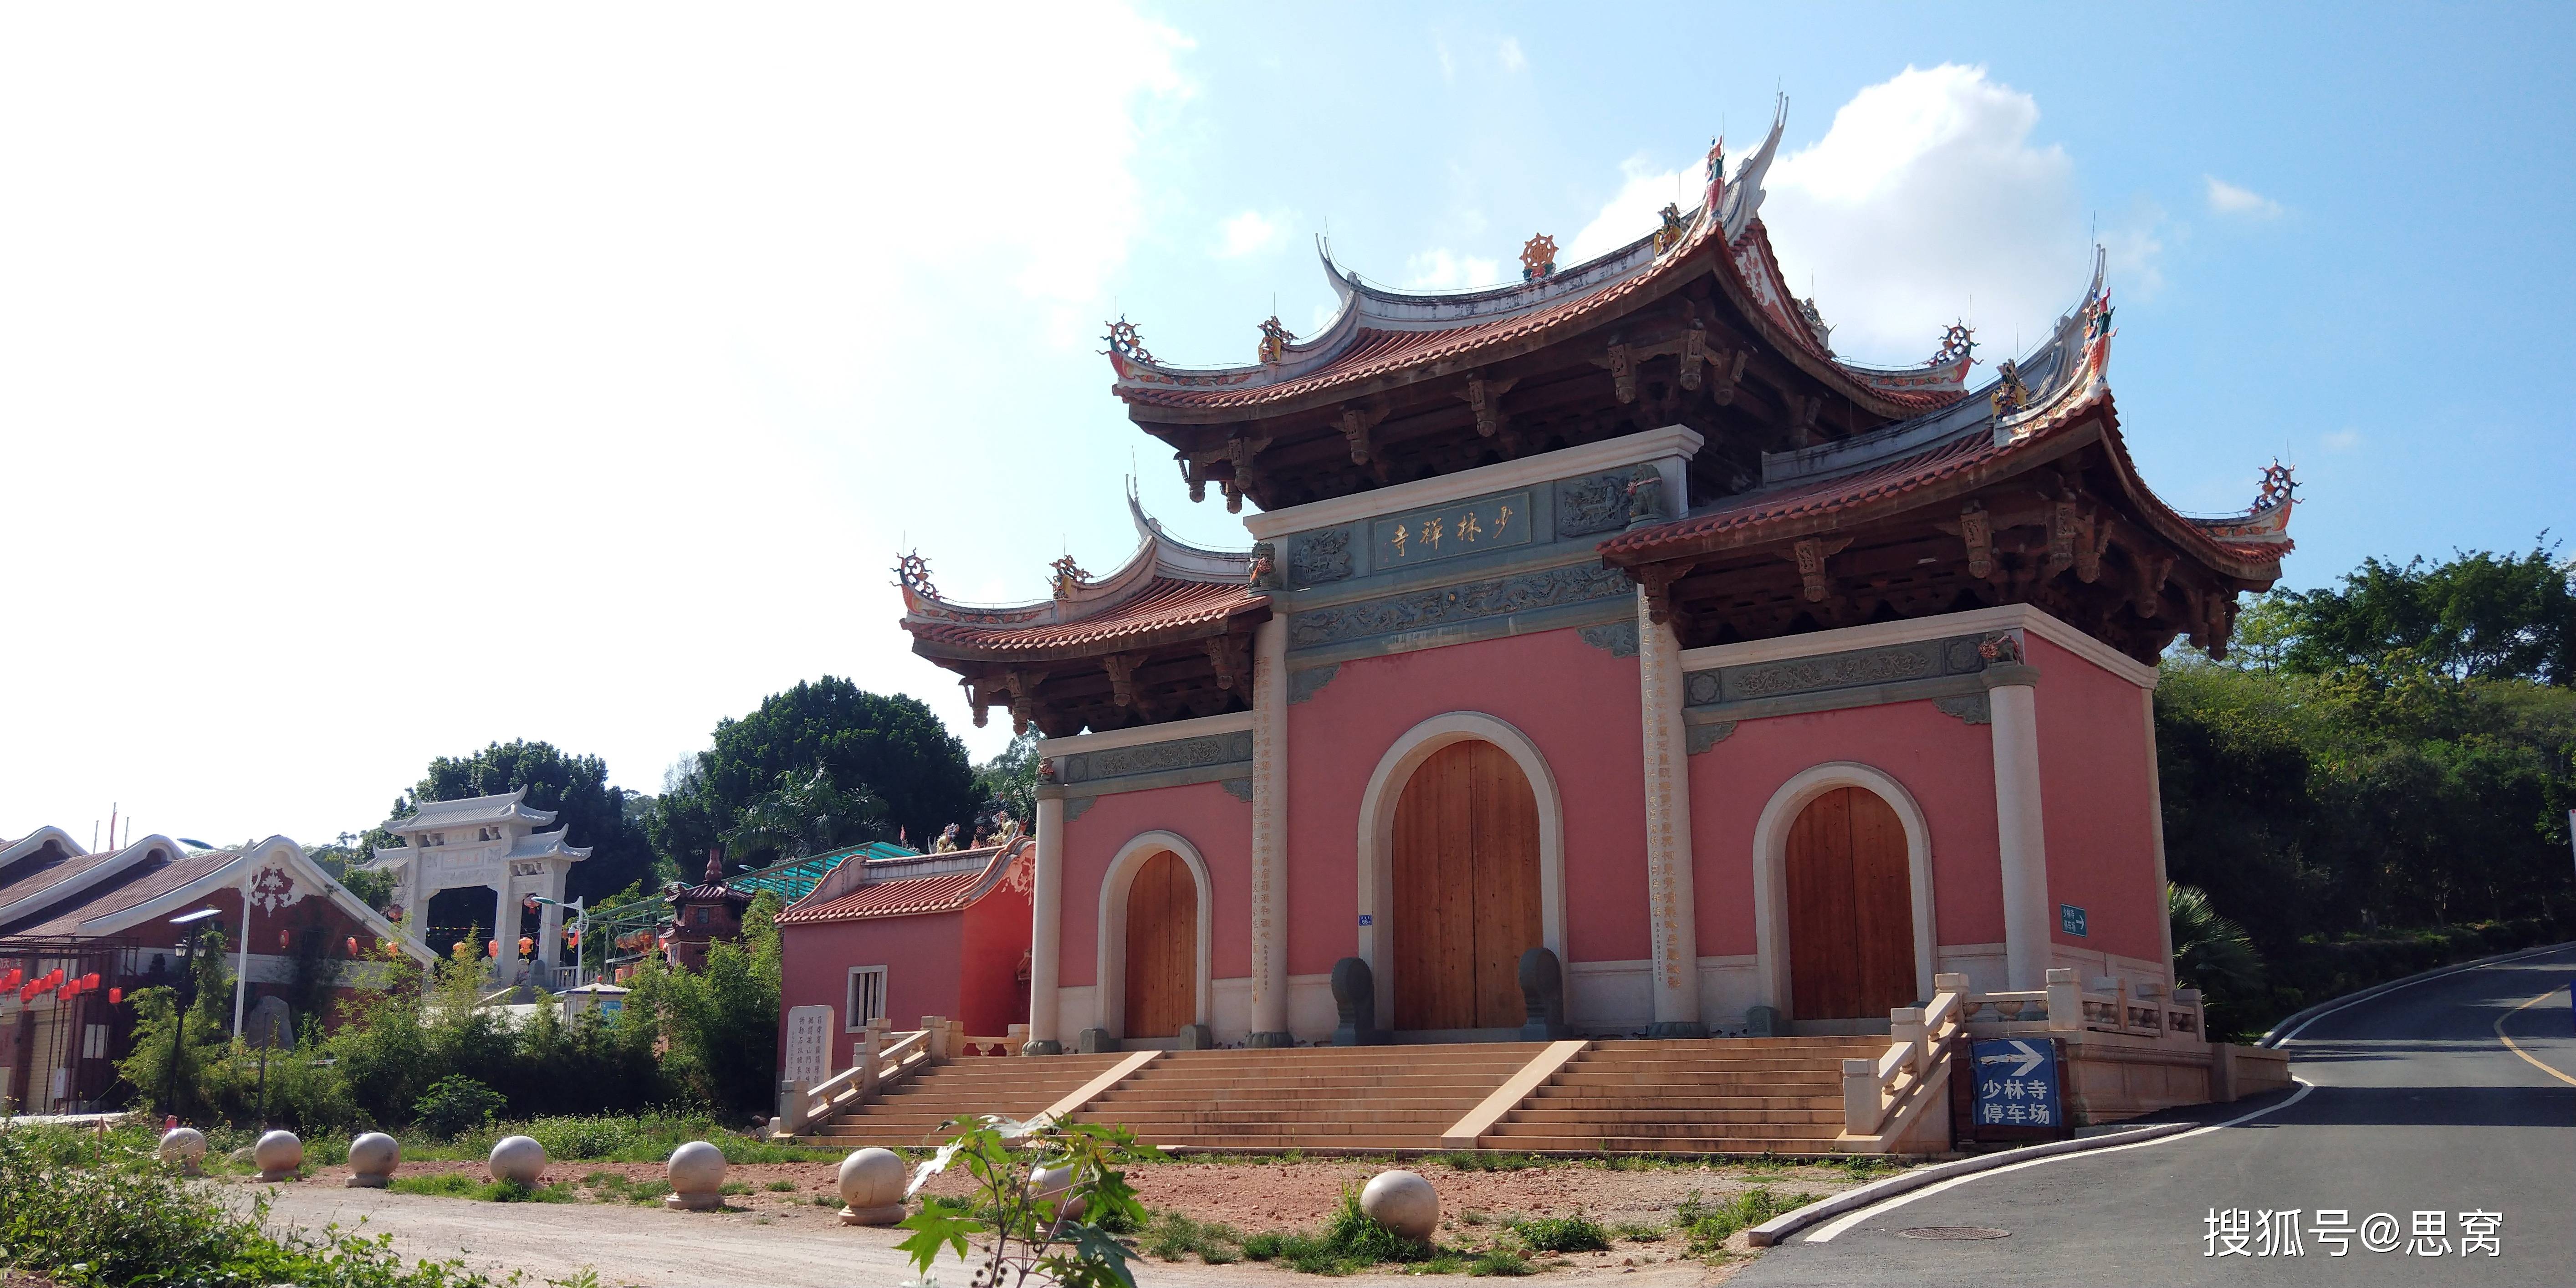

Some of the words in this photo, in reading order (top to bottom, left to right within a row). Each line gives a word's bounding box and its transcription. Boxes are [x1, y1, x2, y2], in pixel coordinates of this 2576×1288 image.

[2063, 907, 2075, 920] 少林寺
[2064, 920, 2076, 932] 停车场
[1983, 1079, 2047, 1100] 少林寺
[1983, 1103, 2050, 1124] 停车场
